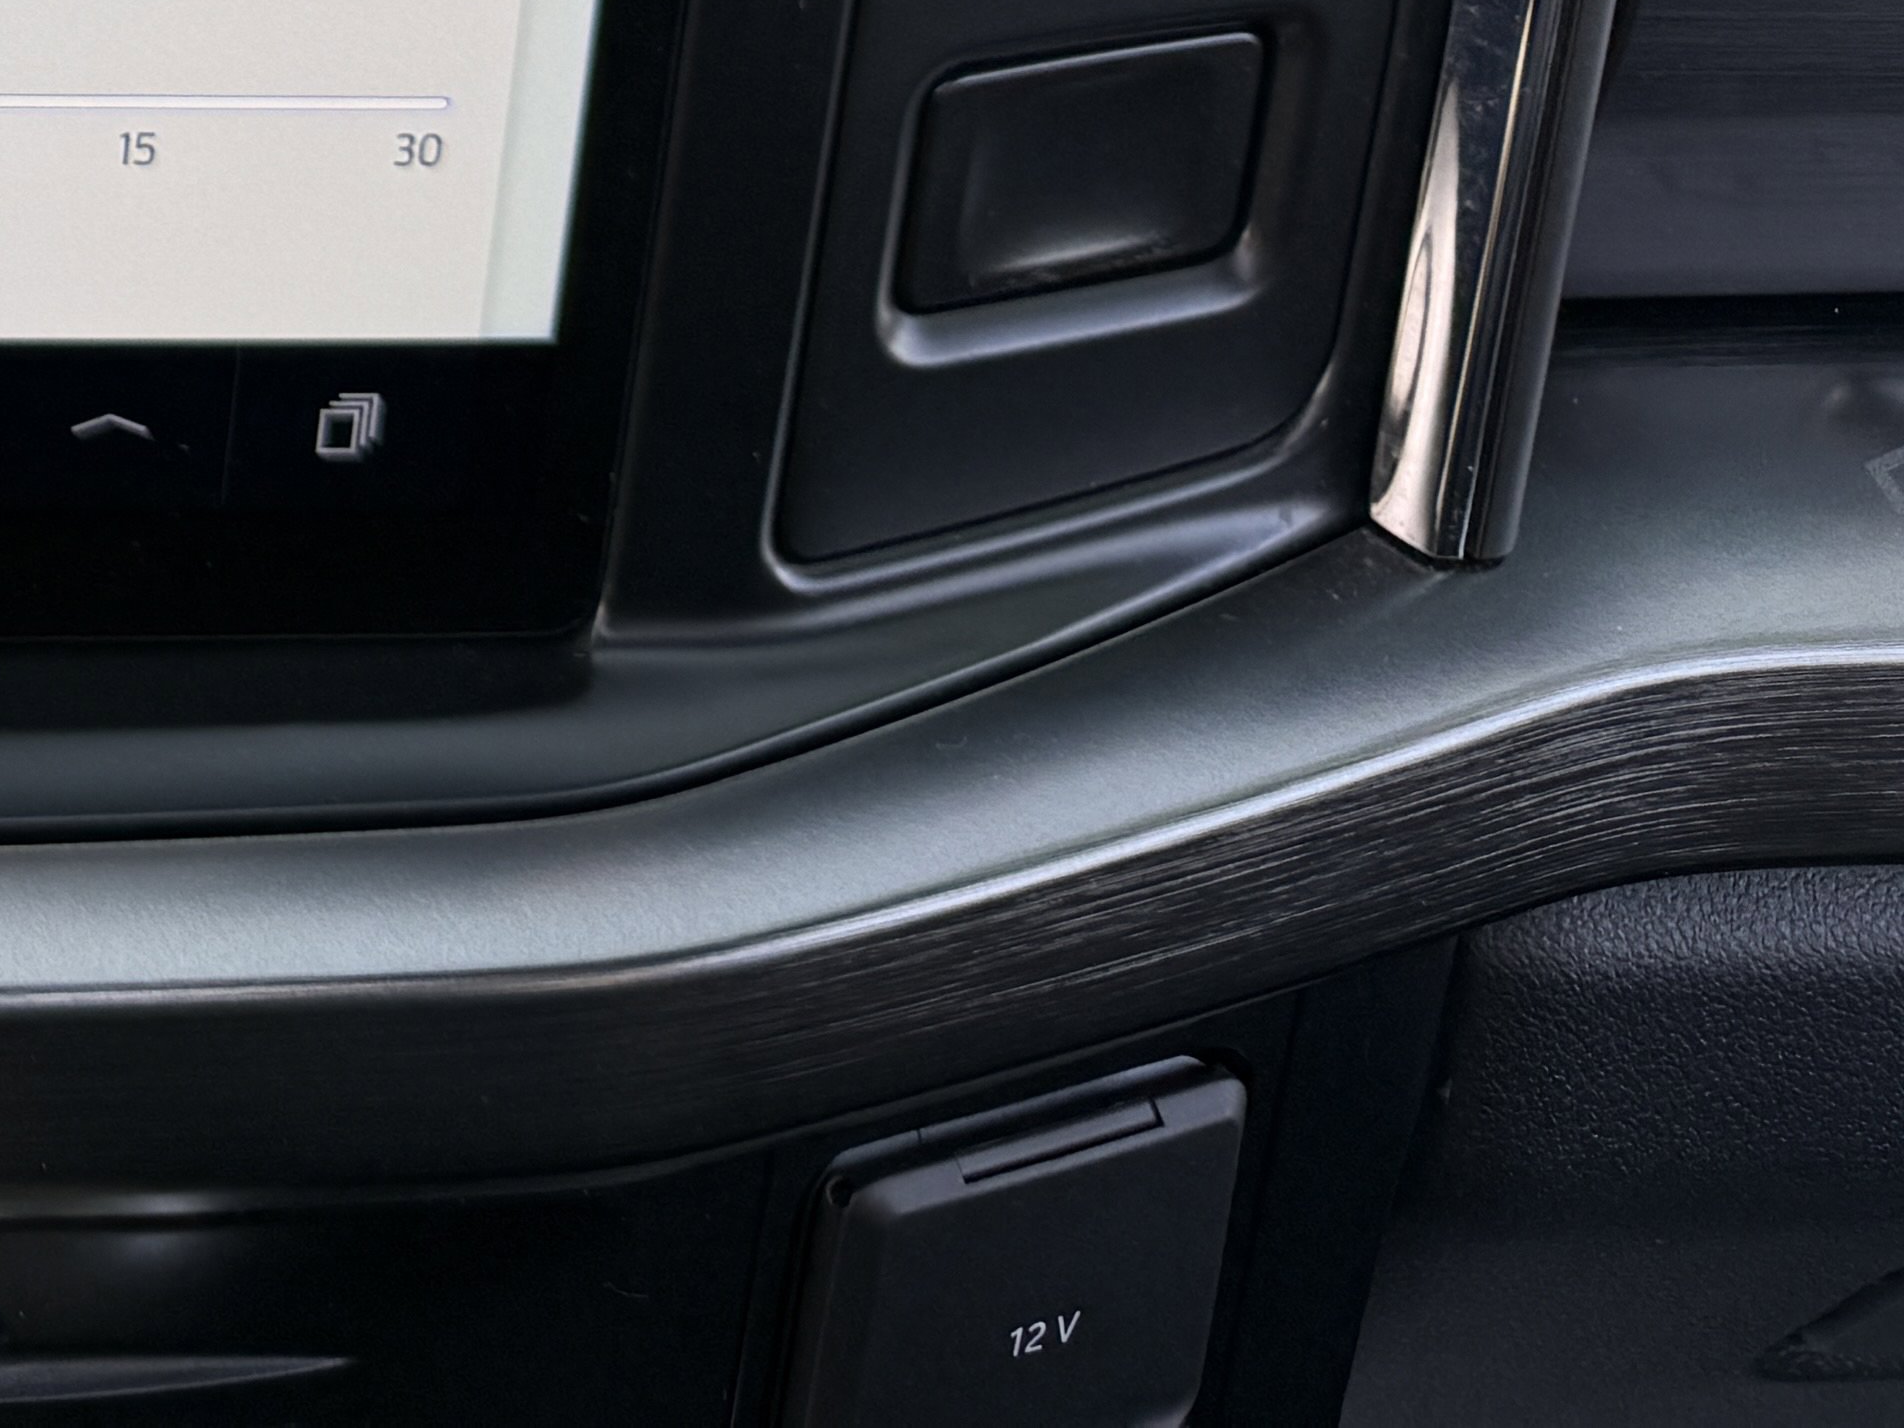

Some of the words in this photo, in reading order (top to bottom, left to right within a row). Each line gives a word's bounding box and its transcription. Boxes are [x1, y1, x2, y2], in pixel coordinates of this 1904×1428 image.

[119, 130, 158, 167] 15
[393, 132, 445, 168] 30
[1010, 1320, 1047, 1357] 12
[1057, 1310, 1081, 1344] V
